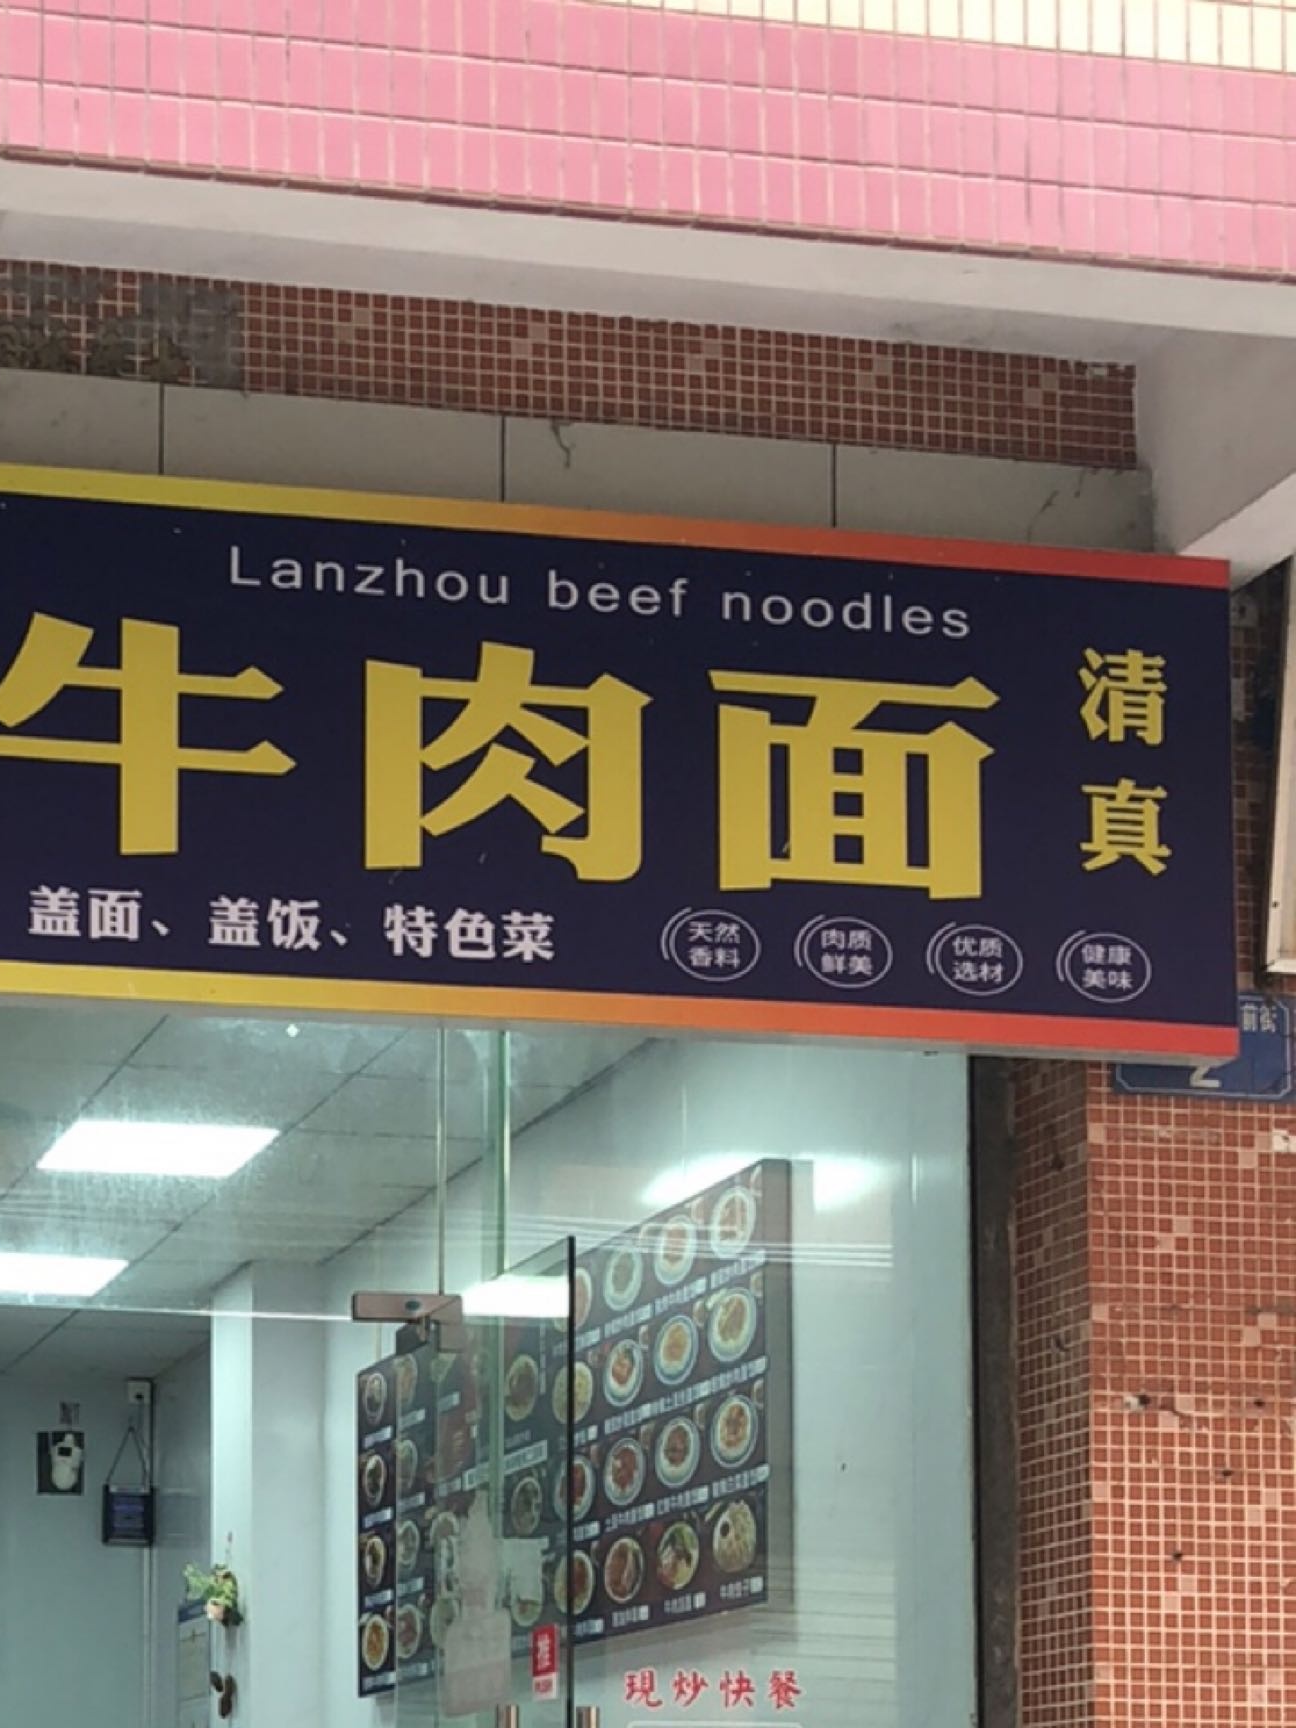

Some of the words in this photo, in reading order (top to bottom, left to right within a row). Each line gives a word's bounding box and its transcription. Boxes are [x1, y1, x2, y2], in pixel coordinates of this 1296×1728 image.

[231, 545, 510, 606] Lanzhou
[549, 570, 688, 617] beef
[722, 588, 971, 639] noodles
[1079, 648, 1172, 876] 清真
[688, 921, 741, 944] 天然
[820, 929, 873, 951] 肉质
[688, 946, 741, 969] 香料
[952, 936, 1003, 959] 优质
[1081, 943, 1132, 966] 健康
[1082, 968, 1133, 990] 美味
